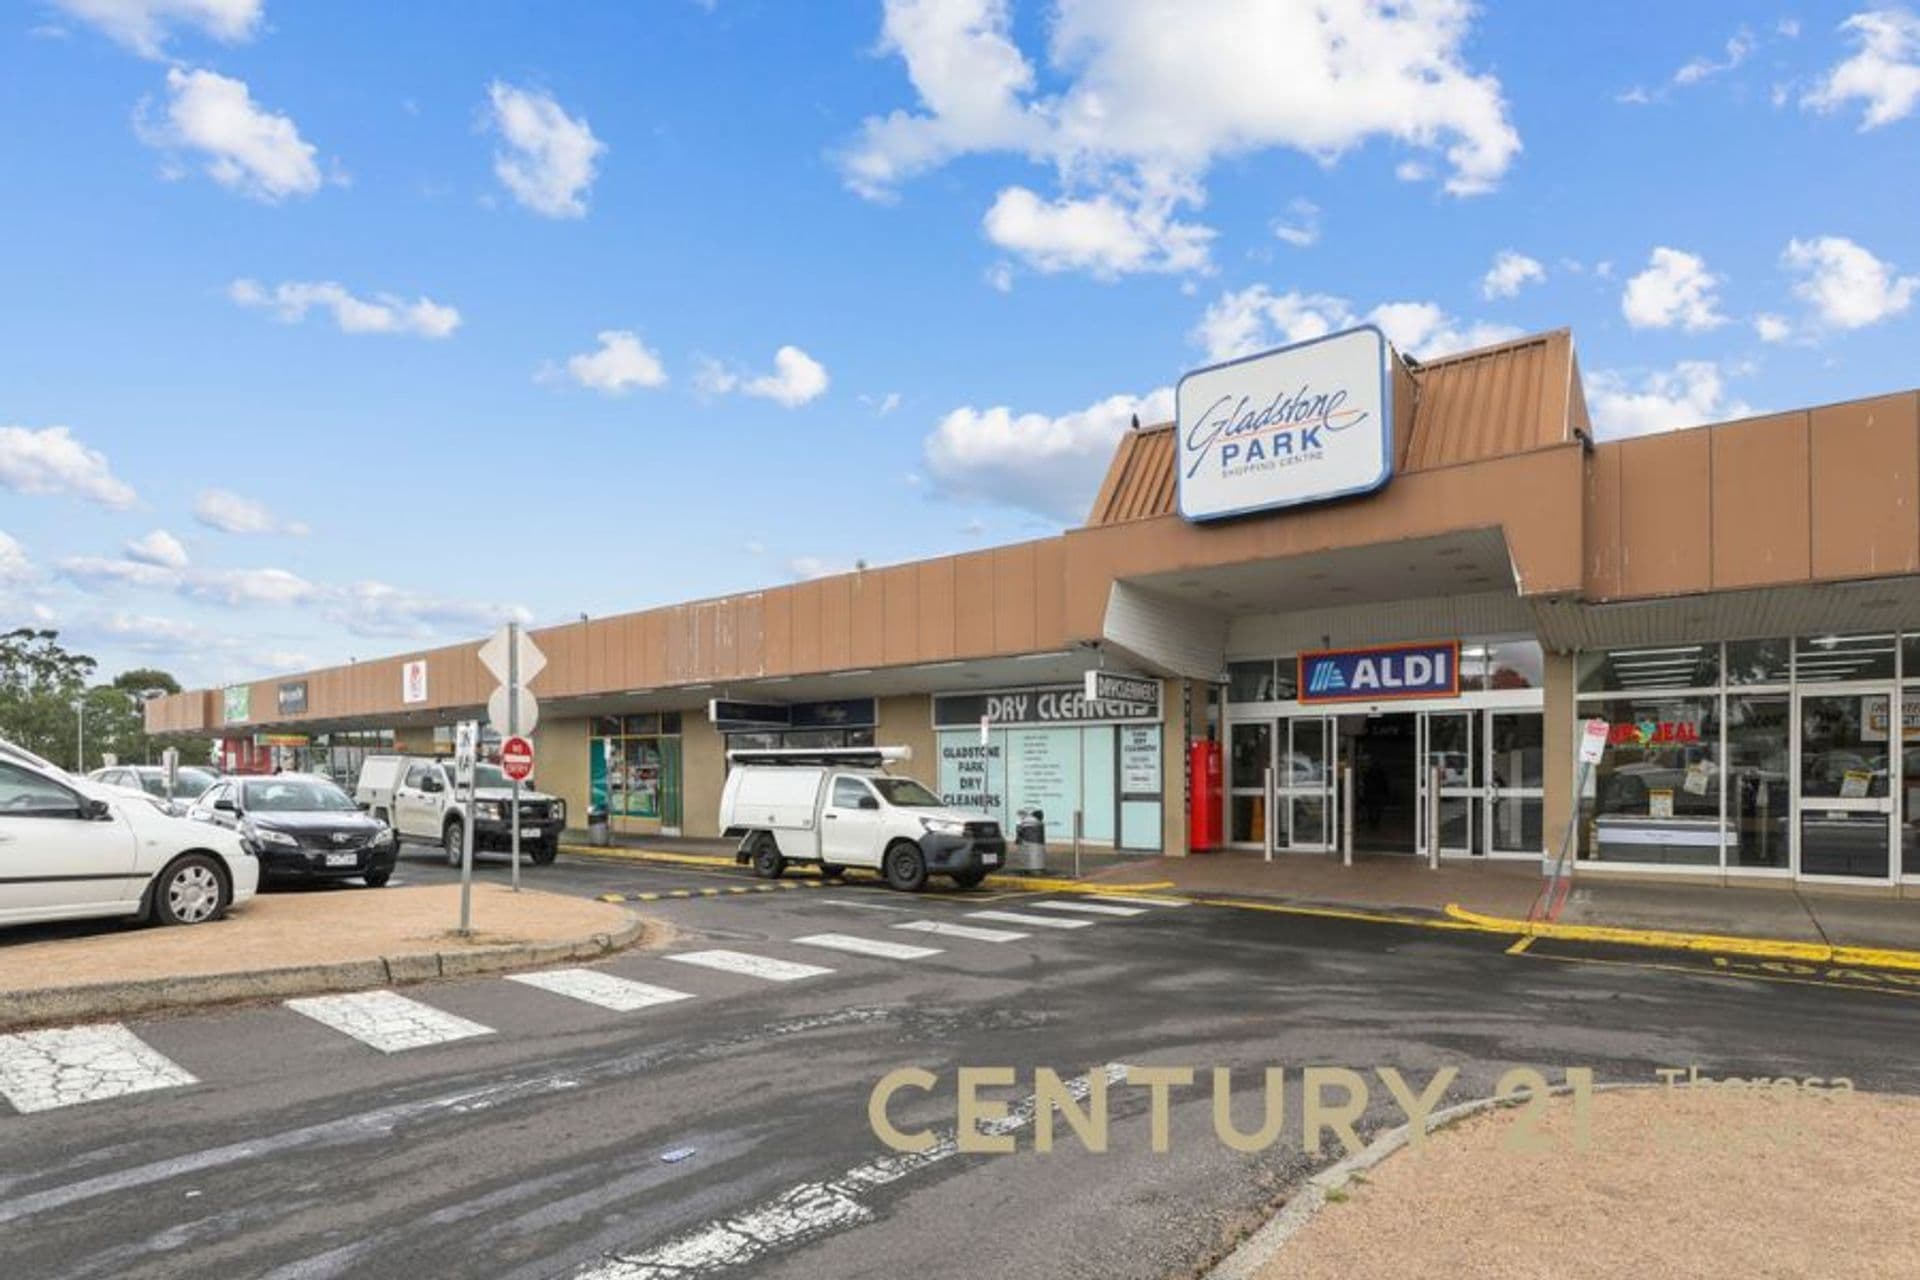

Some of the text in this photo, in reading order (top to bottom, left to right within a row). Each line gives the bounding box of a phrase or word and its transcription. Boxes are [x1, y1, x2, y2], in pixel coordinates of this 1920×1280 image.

[1187, 385, 1368, 478] Gladstone
[1222, 425, 1322, 467] PARK
[1351, 652, 1446, 690] ALDI
[986, 696, 1029, 722] DRY
[958, 761, 984, 773] PARK
[960, 778, 982, 790] DRY
[943, 794, 1001, 808] CLEANERS
